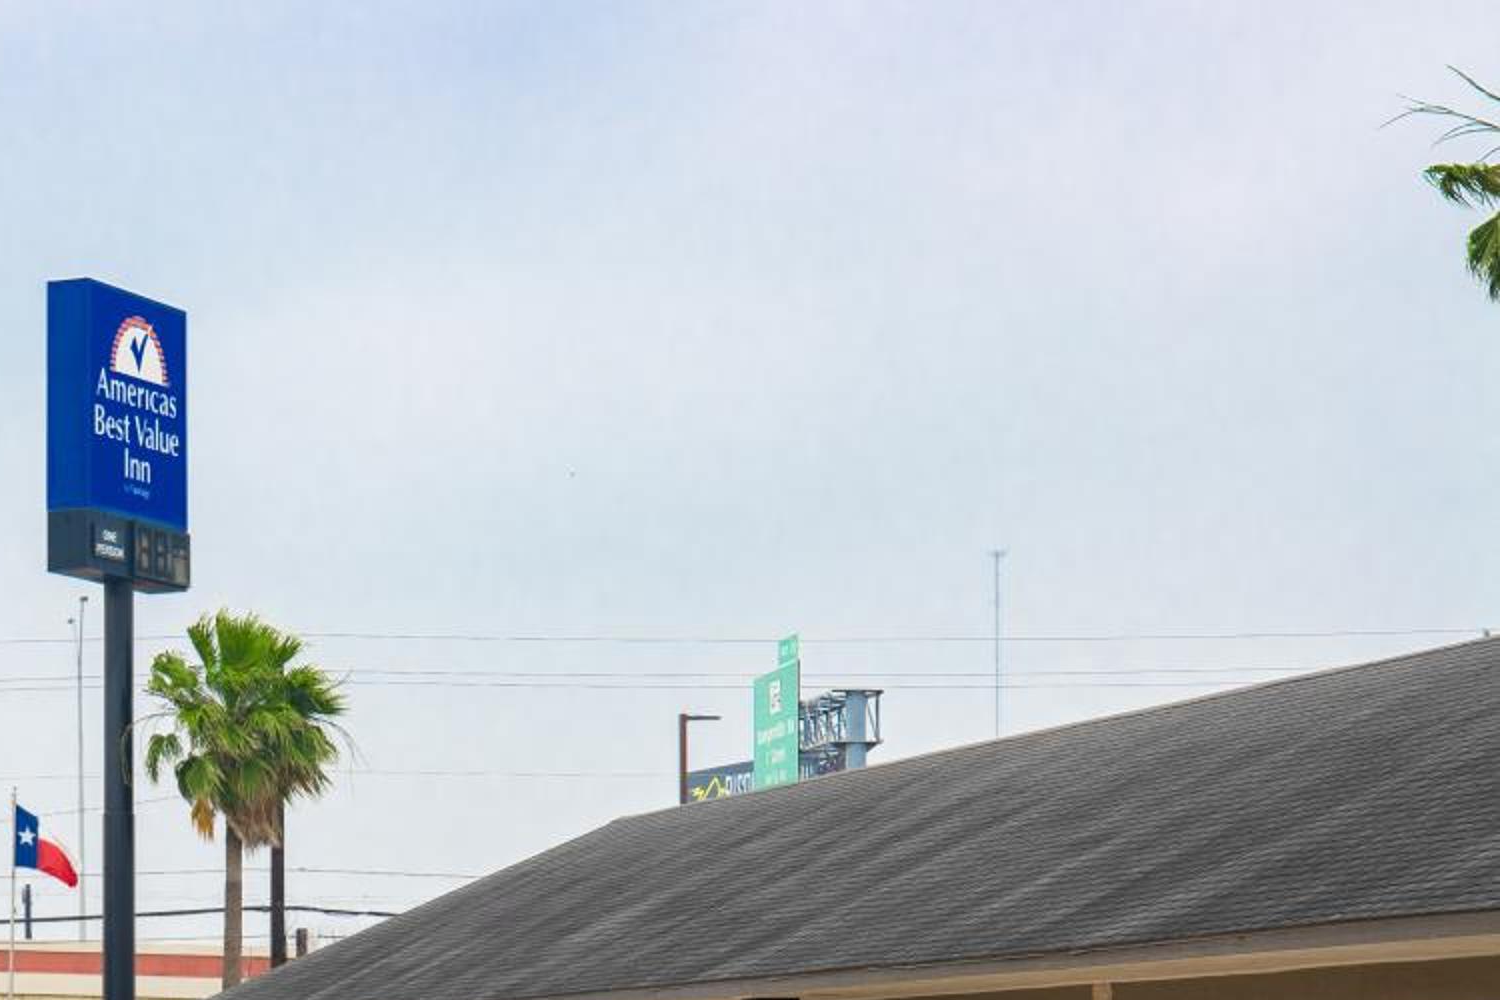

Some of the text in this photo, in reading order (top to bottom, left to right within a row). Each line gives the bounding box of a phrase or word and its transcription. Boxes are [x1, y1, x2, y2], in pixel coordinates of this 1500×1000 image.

[96, 367, 177, 419] Americas
[94, 403, 180, 457] Best Value
[124, 447, 151, 484] Inn
